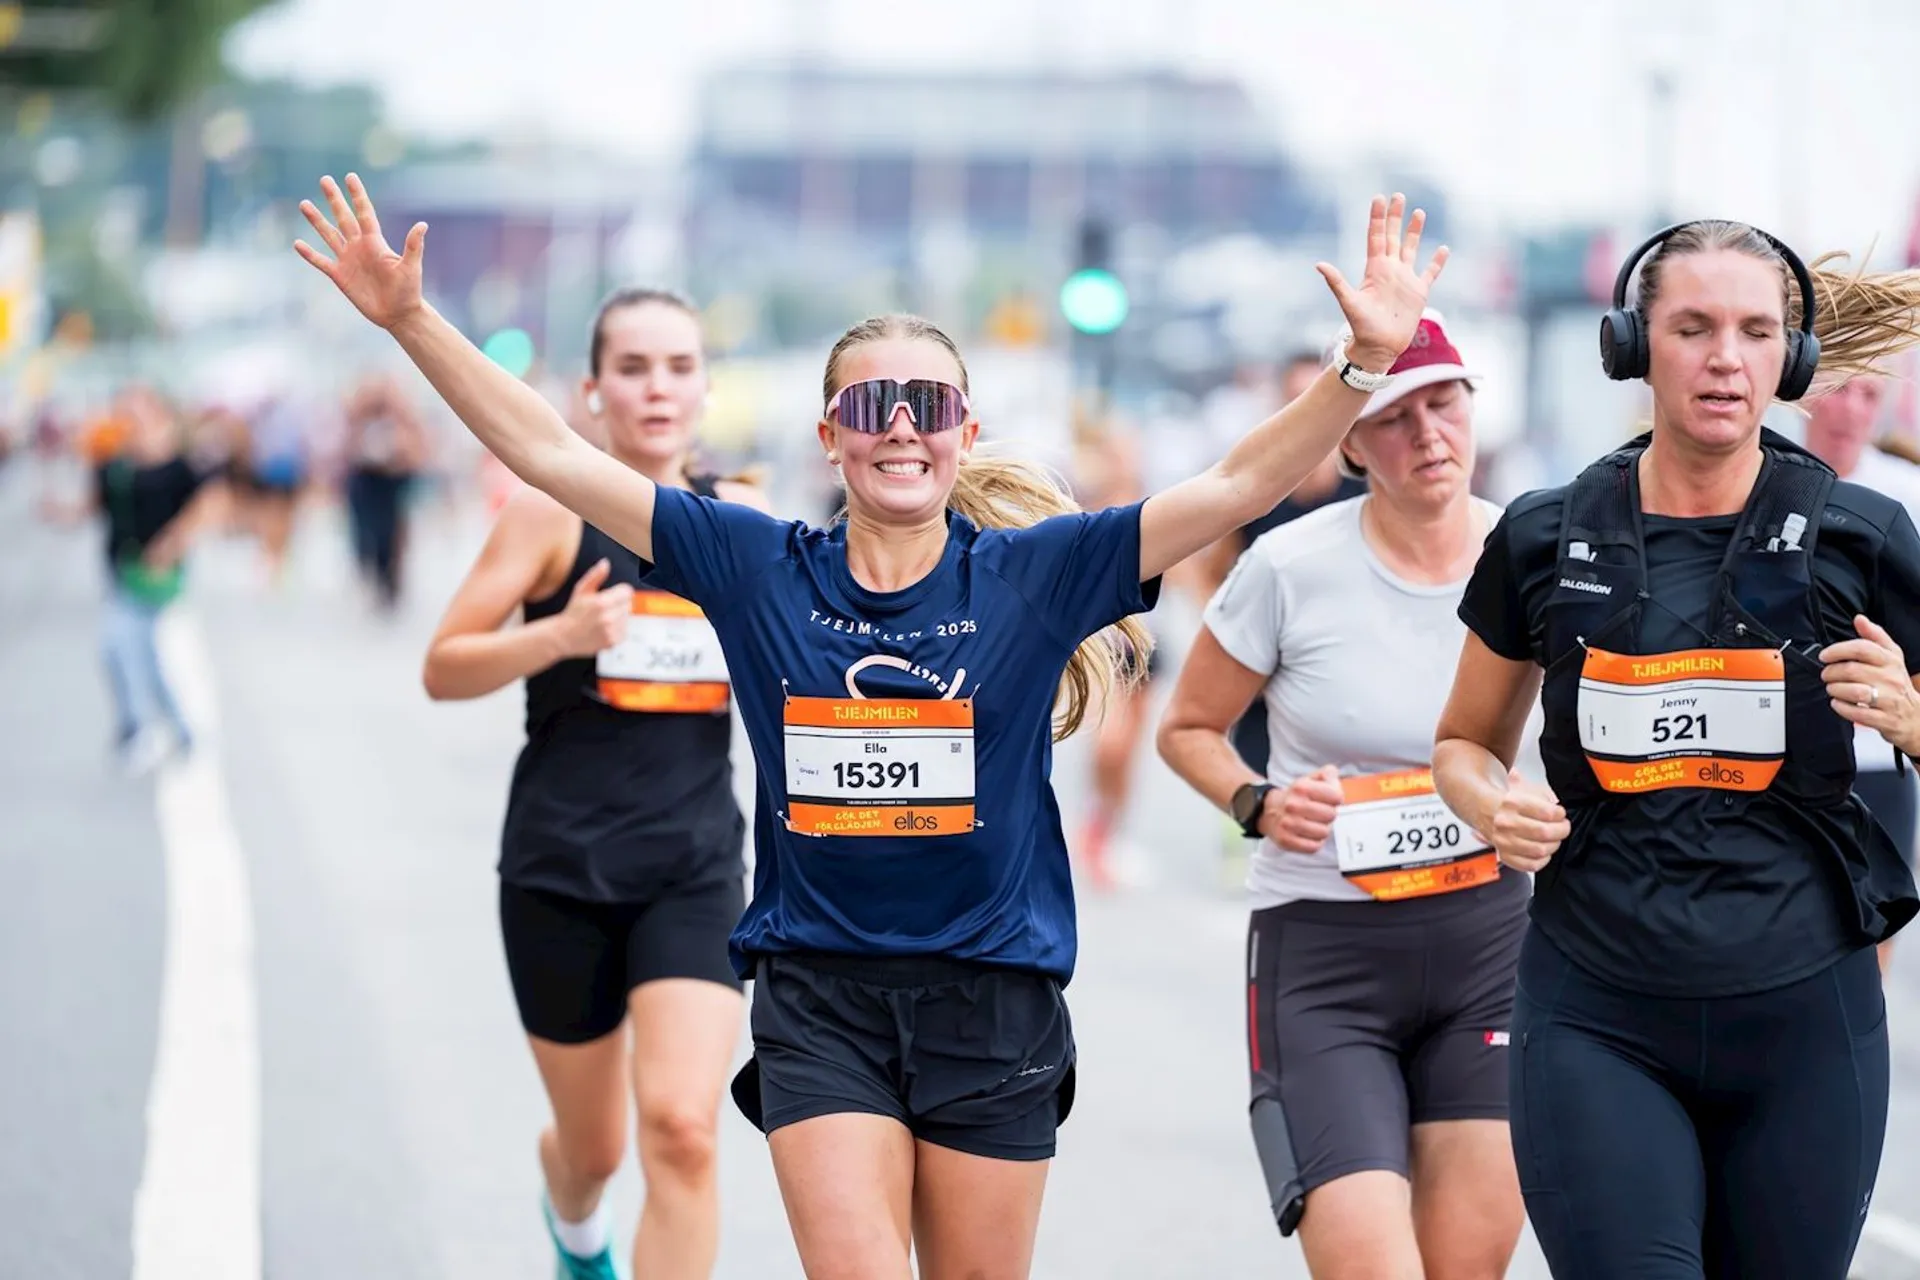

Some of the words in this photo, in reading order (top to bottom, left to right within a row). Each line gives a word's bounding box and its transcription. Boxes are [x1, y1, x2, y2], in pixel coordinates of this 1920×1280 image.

[1559, 578, 1612, 595] SALOMON
[936, 620, 977, 637] 2025
[1632, 657, 1724, 679] TJEJMILEN
[1660, 696, 1698, 710] Jenny
[833, 705, 919, 721] TJEJMILEN
[1601, 725, 1606, 736] 1
[1652, 714, 1708, 744] 521
[865, 743, 887, 754] Ella
[833, 761, 919, 789] 15391
[1699, 763, 1744, 785] ellos
[858, 809, 880, 819] DET
[894, 810, 938, 831] ellos
[1356, 842, 1364, 852] 2
[1387, 823, 1461, 855] 2930
[1443, 866, 1476, 887] ellos
